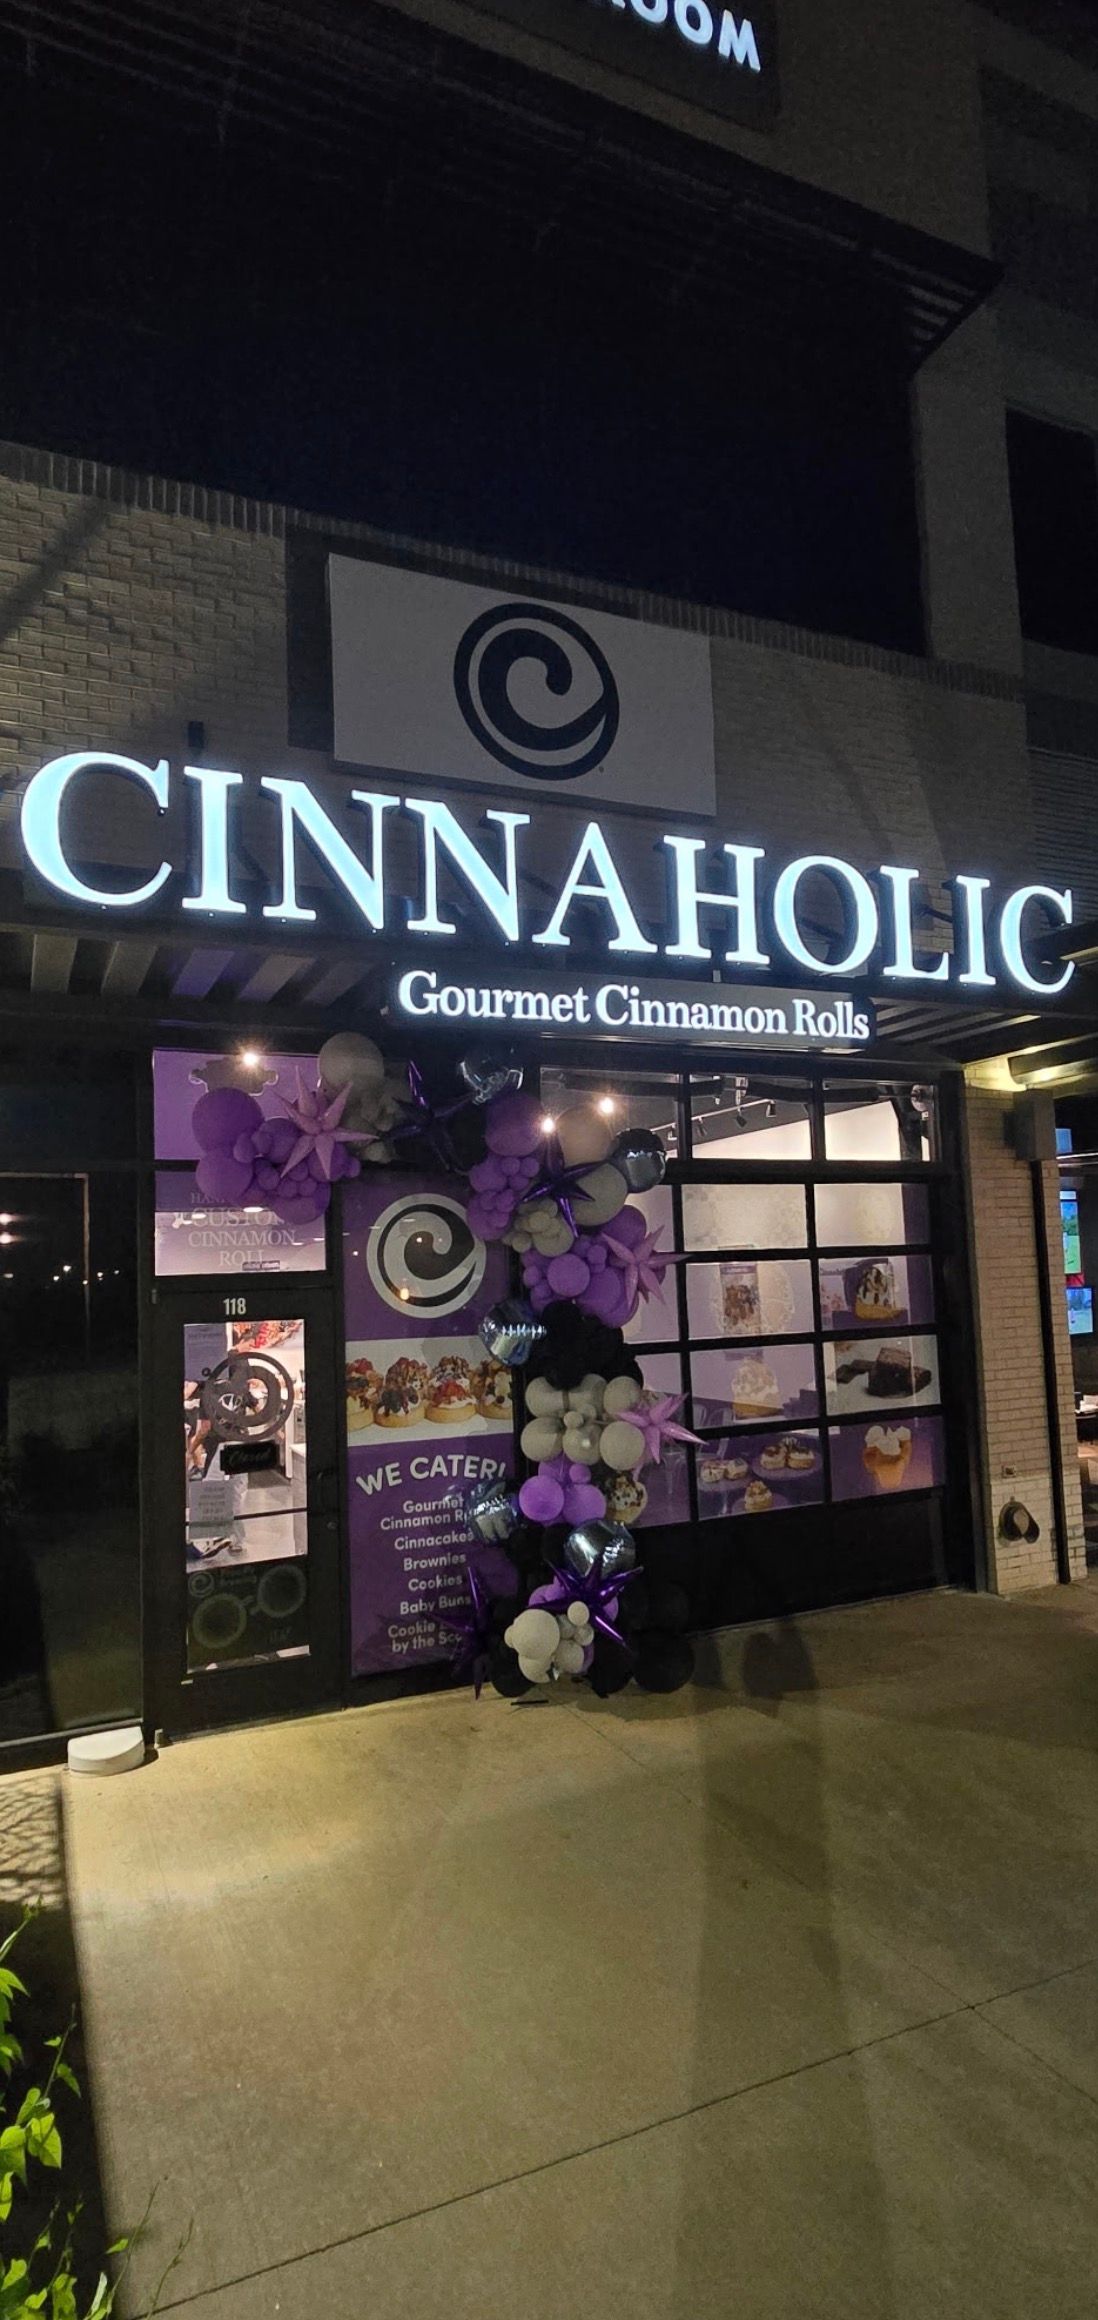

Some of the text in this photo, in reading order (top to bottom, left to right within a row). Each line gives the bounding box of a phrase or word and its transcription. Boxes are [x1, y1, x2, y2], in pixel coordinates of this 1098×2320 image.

[21, 751, 1075, 993] CINNAHOLIC
[398, 970, 870, 1040] Gourmet Cinnamon Rolls
[188, 1230, 297, 1247] CINNAMON
[223, 1297, 247, 1315] 118
[355, 1454, 506, 1496] WE CATER!
[380, 1513, 451, 1531] Cinnamon
[394, 1530, 475, 1551] Cinnacakes
[403, 1552, 467, 1571] Brownies
[408, 1574, 463, 1591] Cookies
[400, 1598, 435, 1615] Baby
[387, 1620, 436, 1639] Cookie
[391, 1639, 409, 1655] by
[412, 1635, 435, 1649] the
